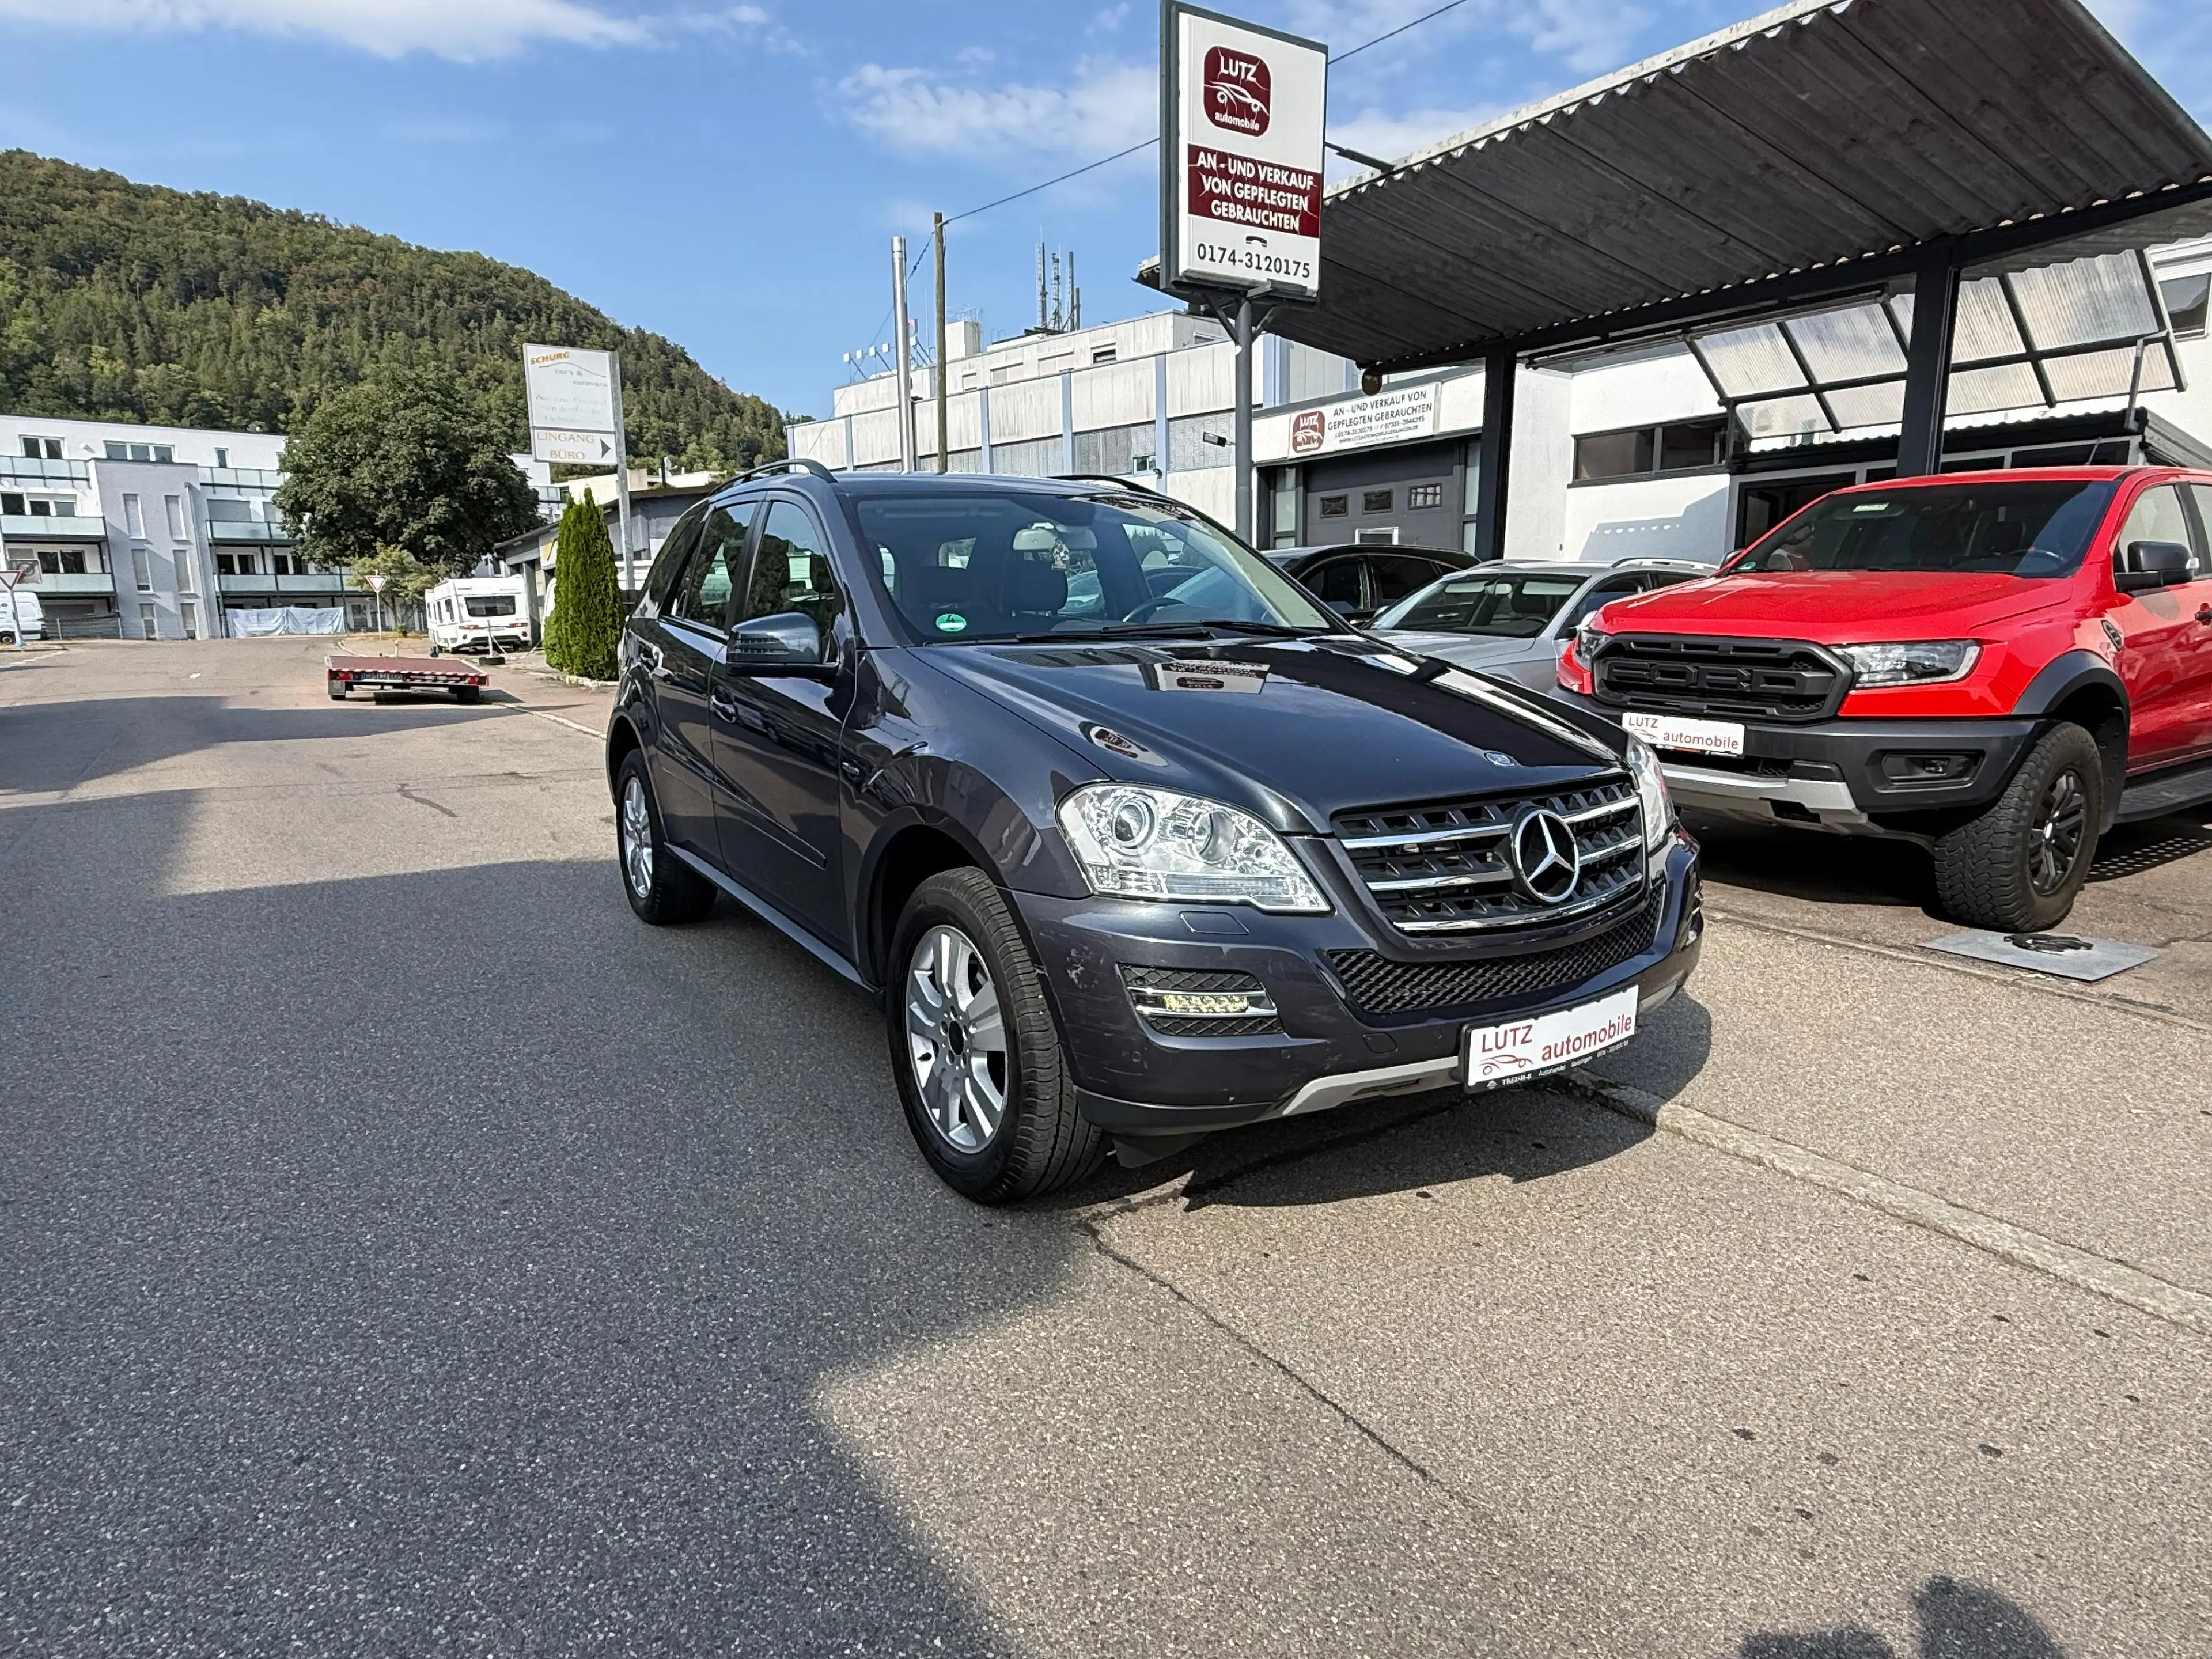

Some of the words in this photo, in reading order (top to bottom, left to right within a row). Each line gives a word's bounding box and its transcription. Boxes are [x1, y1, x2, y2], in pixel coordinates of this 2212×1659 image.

[1220, 56, 1257, 82] LUTZ
[1215, 112, 1260, 131] automobile
[1228, 157, 1255, 178] UND
[1258, 164, 1314, 190] VERKAUF
[1203, 175, 1232, 196] VON
[1234, 183, 1308, 211] GEPFLEGTEN
[1211, 199, 1300, 231] GEBRAUCHTEN
[1197, 243, 1310, 279] 0174-3120175
[1351, 402, 1368, 414] UND
[1370, 394, 1406, 410] VERKAUF
[1407, 390, 1427, 402] VON
[1300, 415, 1319, 427] LUTZ
[1327, 414, 1373, 431] GEPFLEGTEN
[1374, 403, 1432, 422] GEBRAUCHTEN
[536, 431, 595, 444] EINGANG
[550, 449, 585, 460] BÜRO
[1628, 715, 1658, 729] LUTZ
[1663, 732, 1739, 749] automobile
[1482, 1024, 1533, 1053] LUTZ
[1541, 1014, 1631, 1062] automobile
